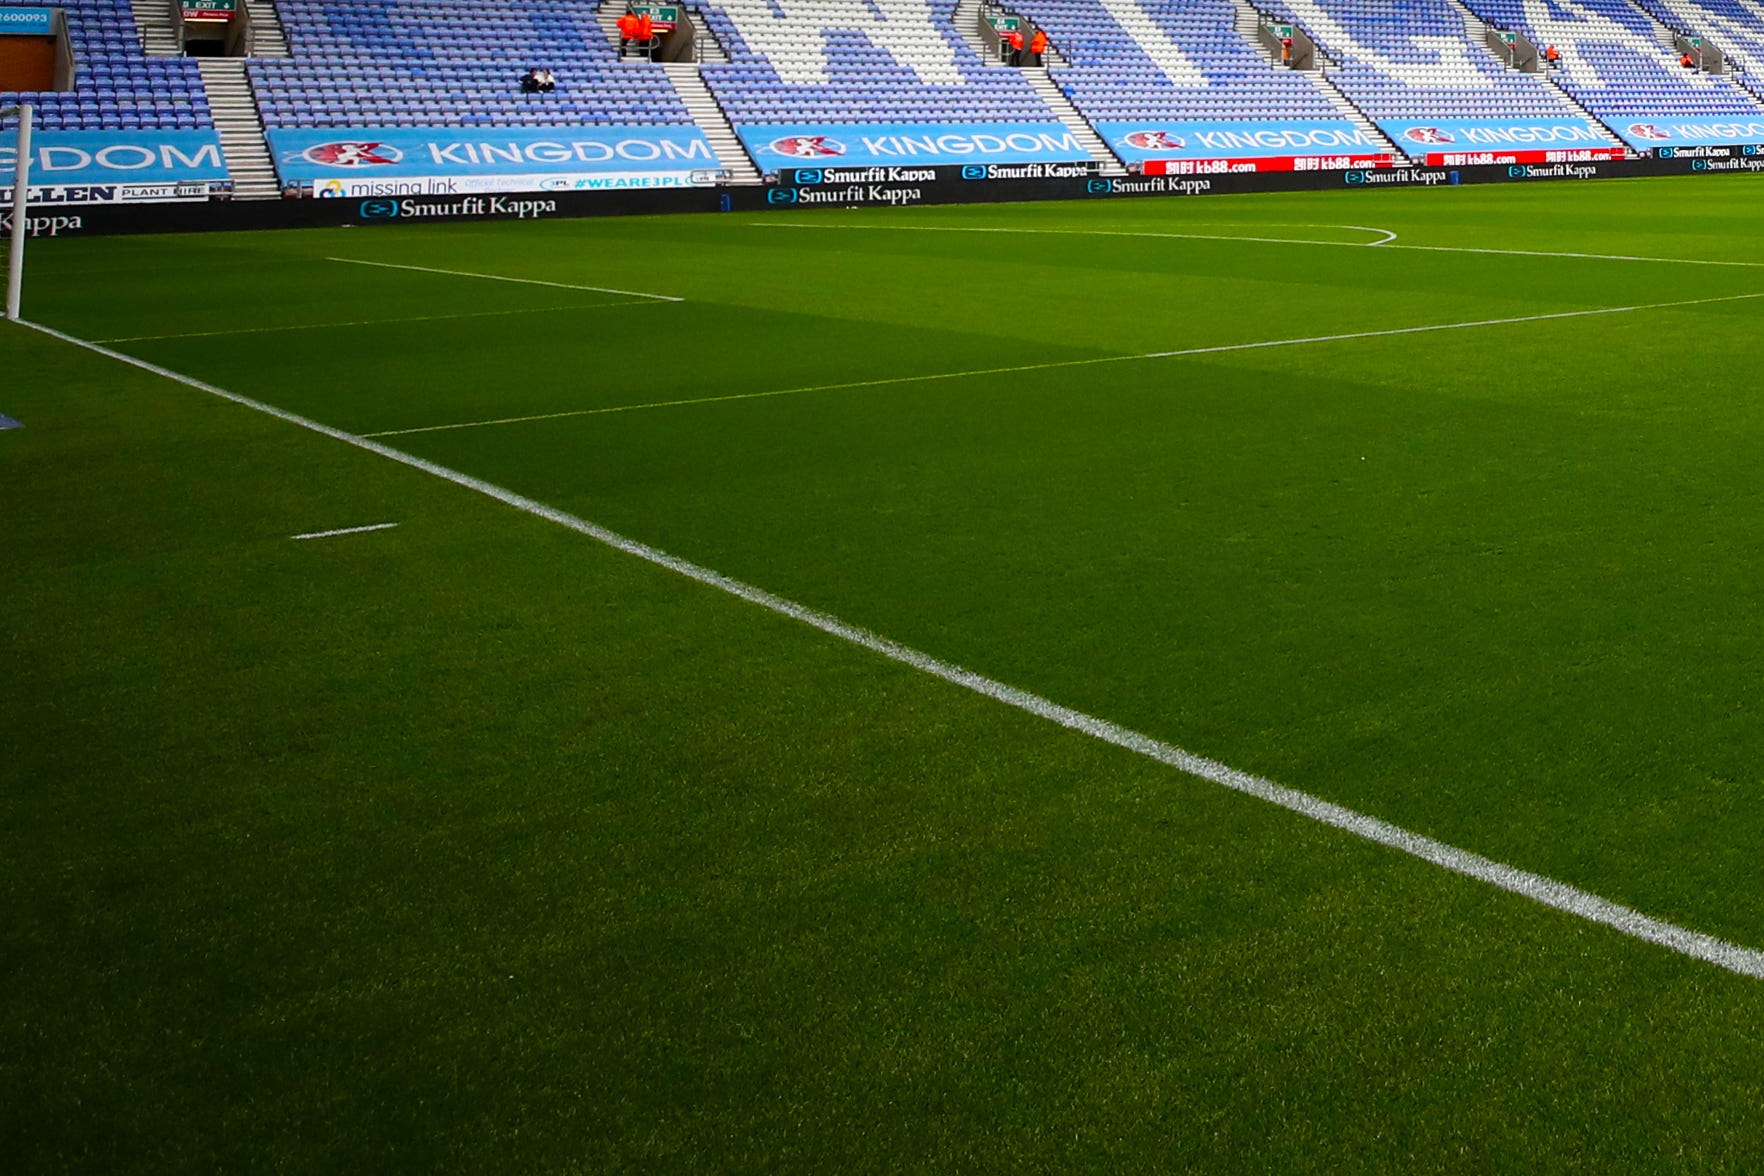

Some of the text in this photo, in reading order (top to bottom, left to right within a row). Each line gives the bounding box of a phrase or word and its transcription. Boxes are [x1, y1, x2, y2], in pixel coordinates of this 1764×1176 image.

[195, 1, 216, 9] EXIT
[1194, 128, 1372, 149] KINGDOM
[1459, 123, 1603, 143] KINGDOM
[861, 132, 1083, 155] KINGDOM
[1673, 146, 1730, 157] Smurfit Kappa
[430, 139, 713, 165] KINGDOM
[1467, 152, 1516, 165] kb88.com
[988, 164, 1088, 179] Smurfit Kappa
[1196, 160, 1256, 173] kb88.com
[1527, 163, 1596, 178] Smurfit Kappa
[1707, 157, 1739, 170] Smurfit
[824, 165, 935, 183] Smurfit Kappa
[1364, 168, 1446, 184] Smurfit Kappa
[122, 189, 167, 197] PLANT
[351, 177, 457, 195] missing link
[1112, 177, 1211, 194] Smurfit Kappa
[799, 184, 921, 205] Smurfit Kappa
[401, 197, 556, 219] Smurfit Kappa
